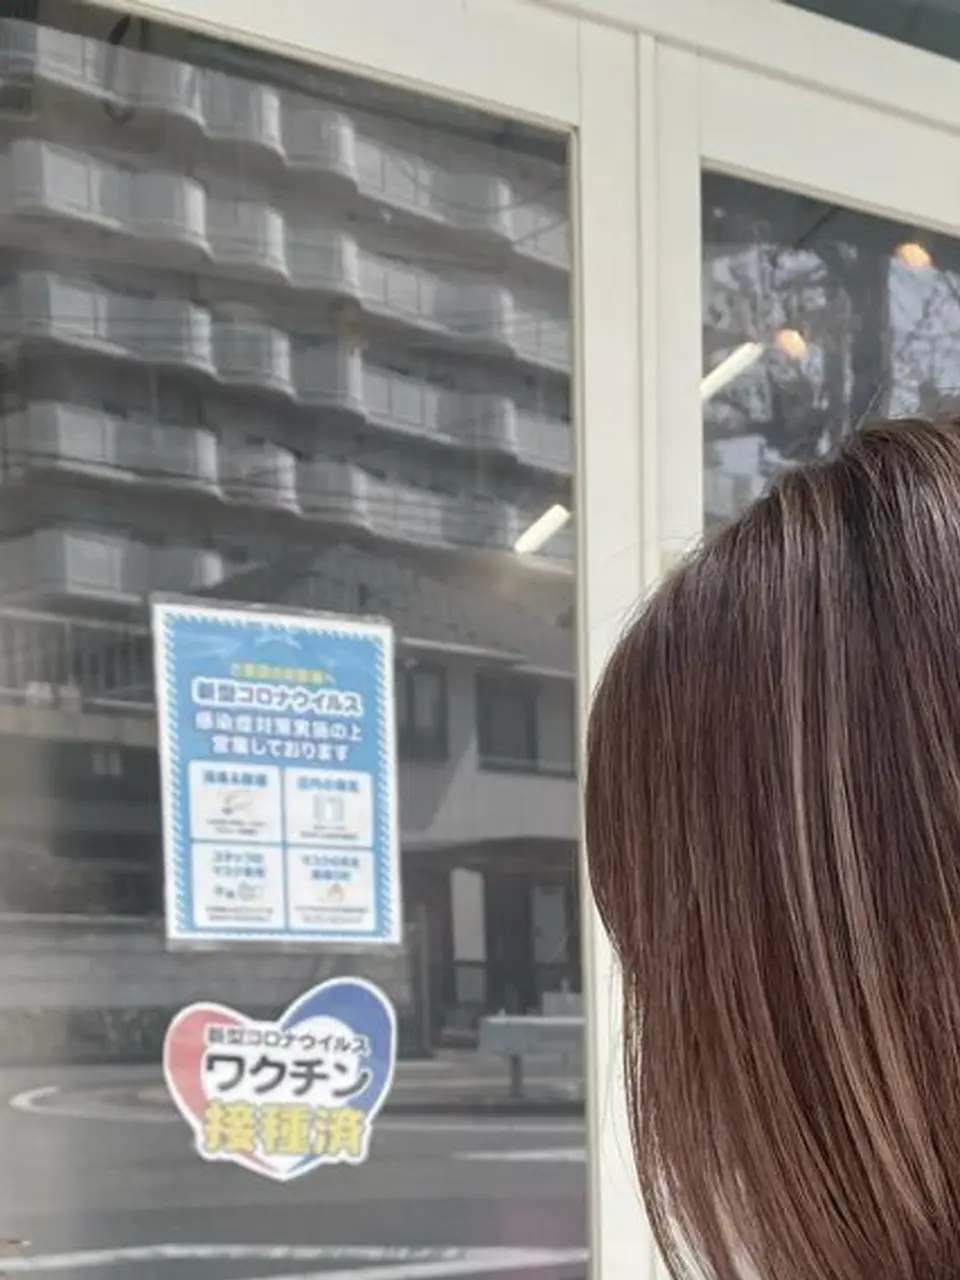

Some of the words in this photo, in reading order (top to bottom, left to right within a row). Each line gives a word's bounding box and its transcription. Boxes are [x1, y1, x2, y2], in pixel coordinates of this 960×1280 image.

[207, 1026, 369, 1055] 新型コロナウイルス
[206, 1054, 370, 1097] ワクチン
[204, 1099, 365, 1156] 接種済
